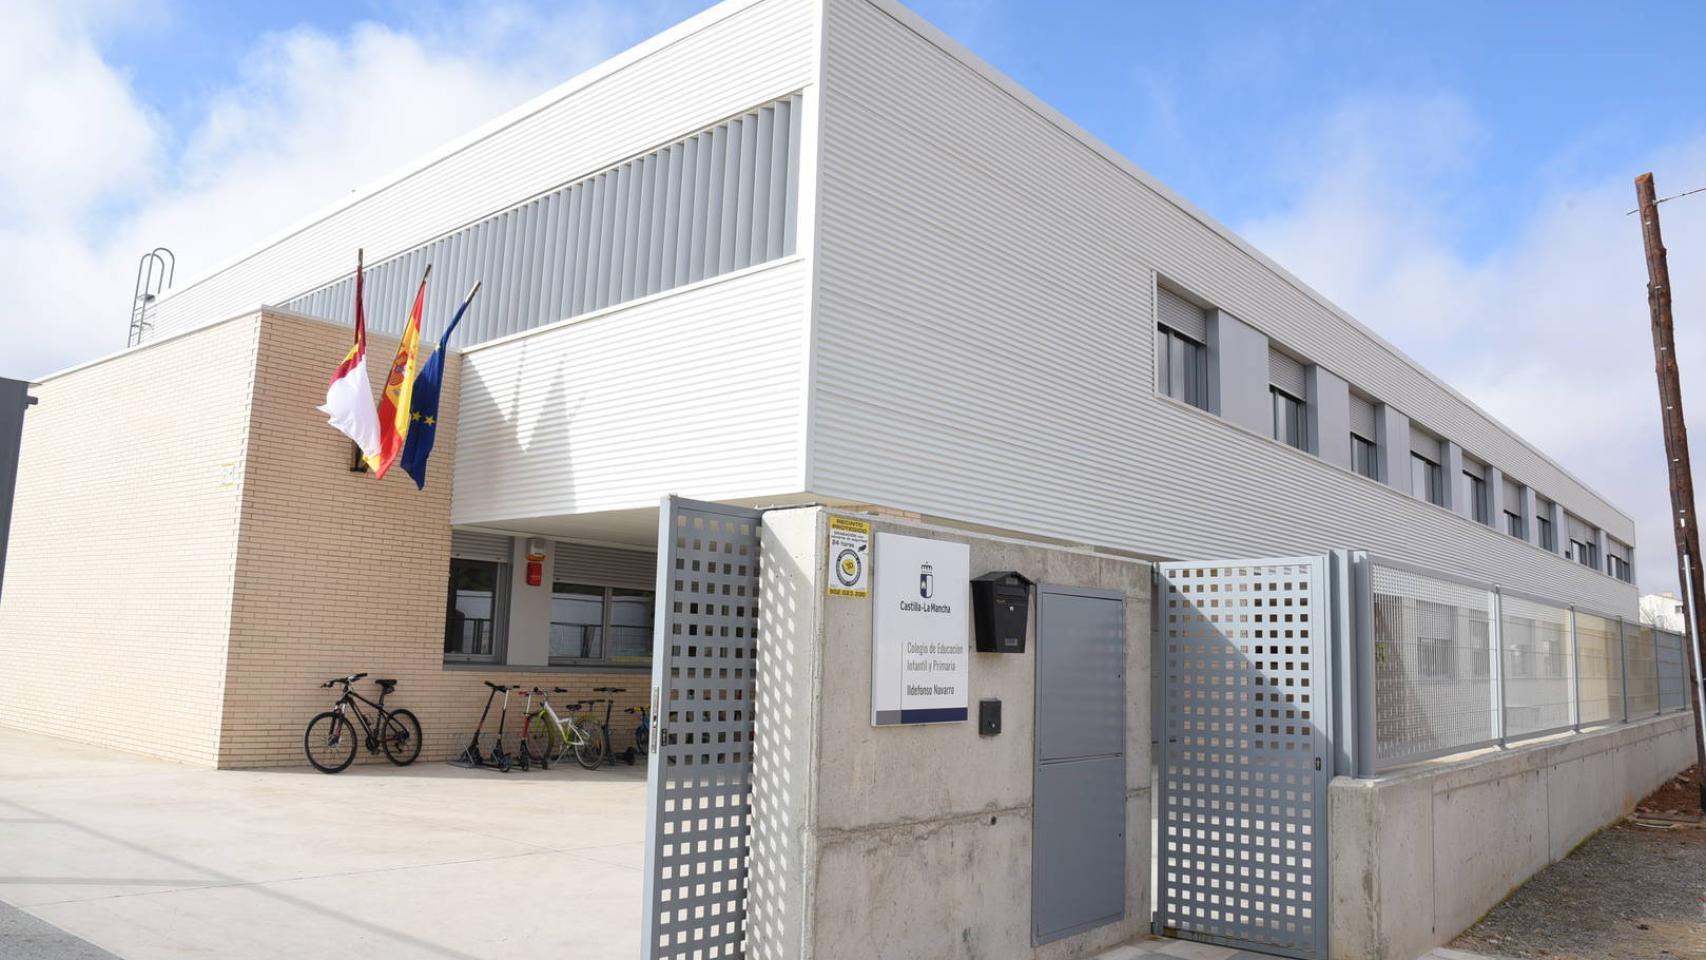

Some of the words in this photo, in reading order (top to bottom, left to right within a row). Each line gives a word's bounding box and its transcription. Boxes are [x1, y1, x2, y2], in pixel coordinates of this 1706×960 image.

[931, 602, 951, 613] Mancha
[907, 641, 928, 656] Colegio
[929, 642, 936, 654] de
[907, 659, 927, 671] Infantil
[933, 659, 955, 671] Primaria
[906, 683, 932, 696] Ildefonso
[933, 683, 955, 695] Navarro
